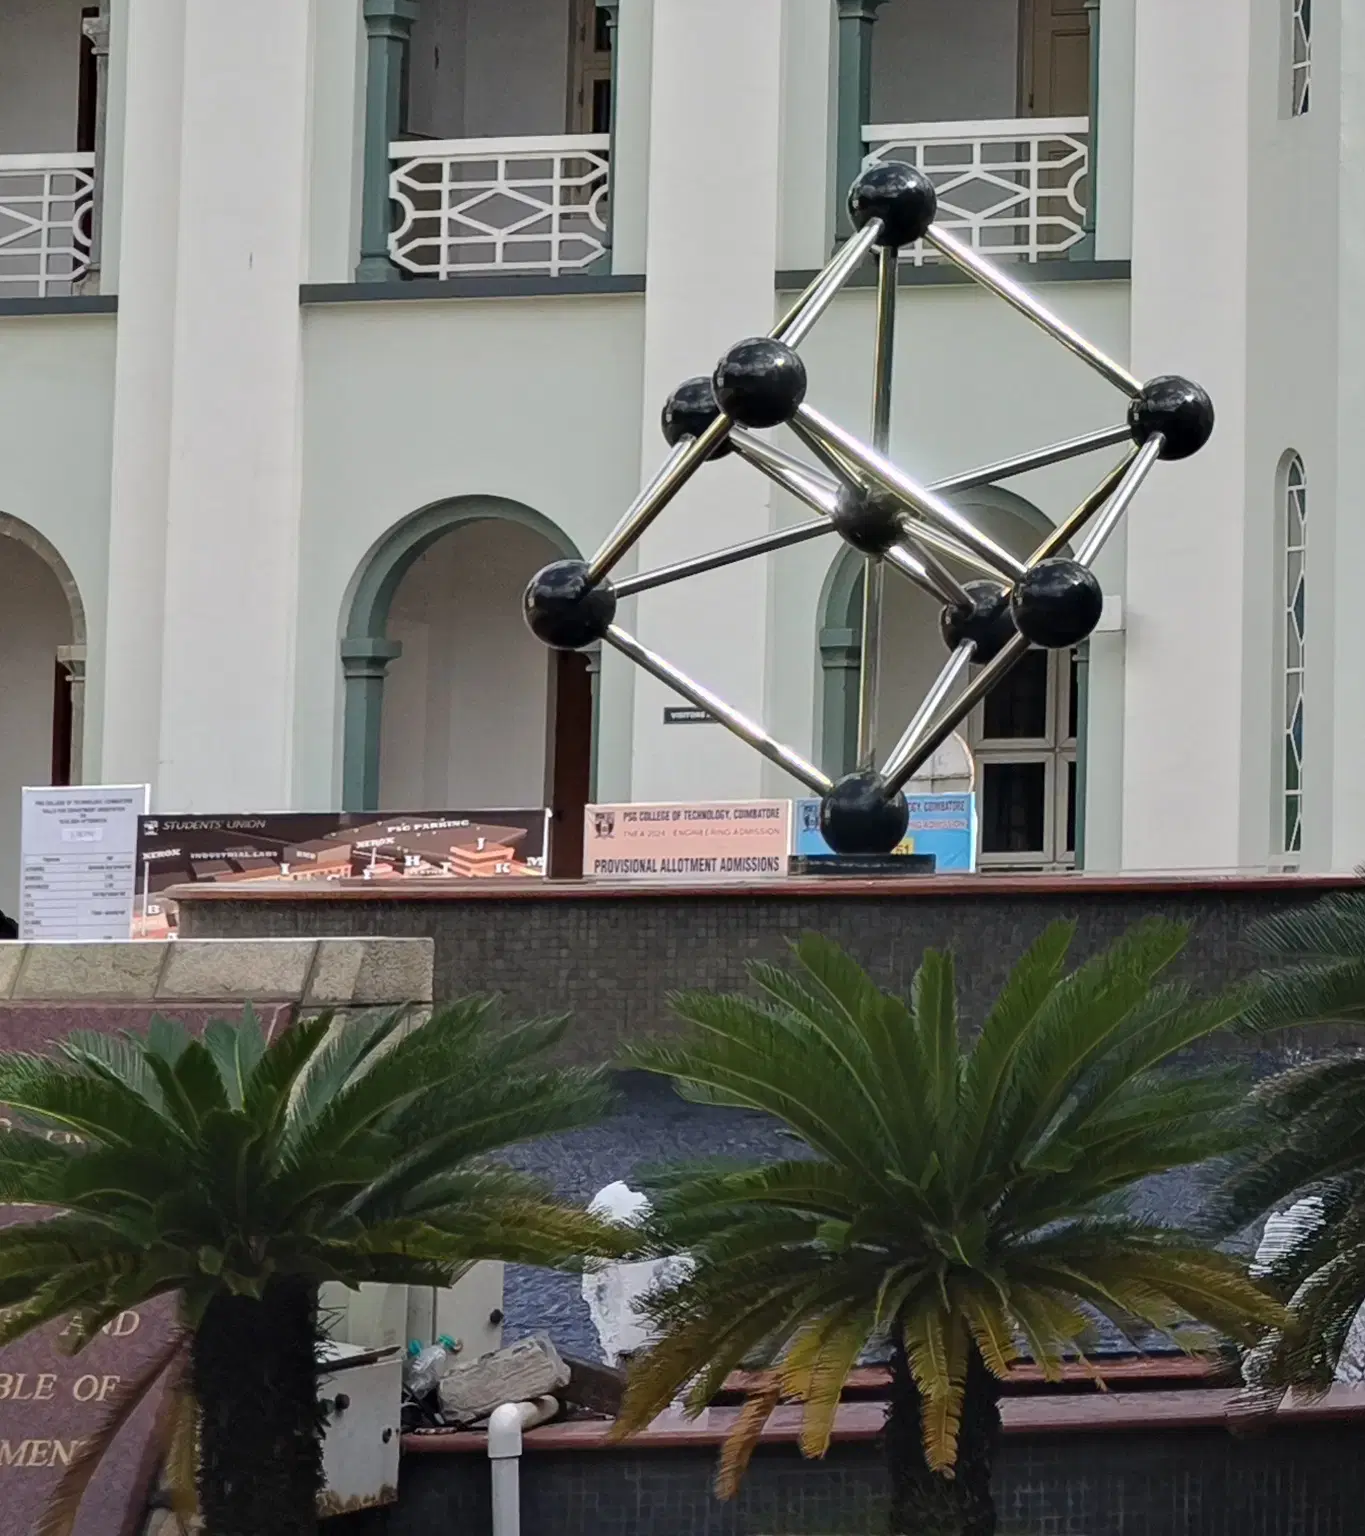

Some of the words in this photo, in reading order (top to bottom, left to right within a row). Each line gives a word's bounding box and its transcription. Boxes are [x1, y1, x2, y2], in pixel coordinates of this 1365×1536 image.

[639, 810, 670, 821] COLLEGE
[672, 810, 682, 821] OF
[733, 808, 780, 819] COIMBATORE
[226, 820, 267, 829] UNION
[733, 827, 780, 836] ADMISSION
[404, 854, 420, 867] H
[594, 859, 657, 874] PROVISIONAL
[660, 857, 717, 873] ALLOTMENT
[720, 856, 780, 872] ADMISSIONS
[72, 1374, 120, 1401] OF
